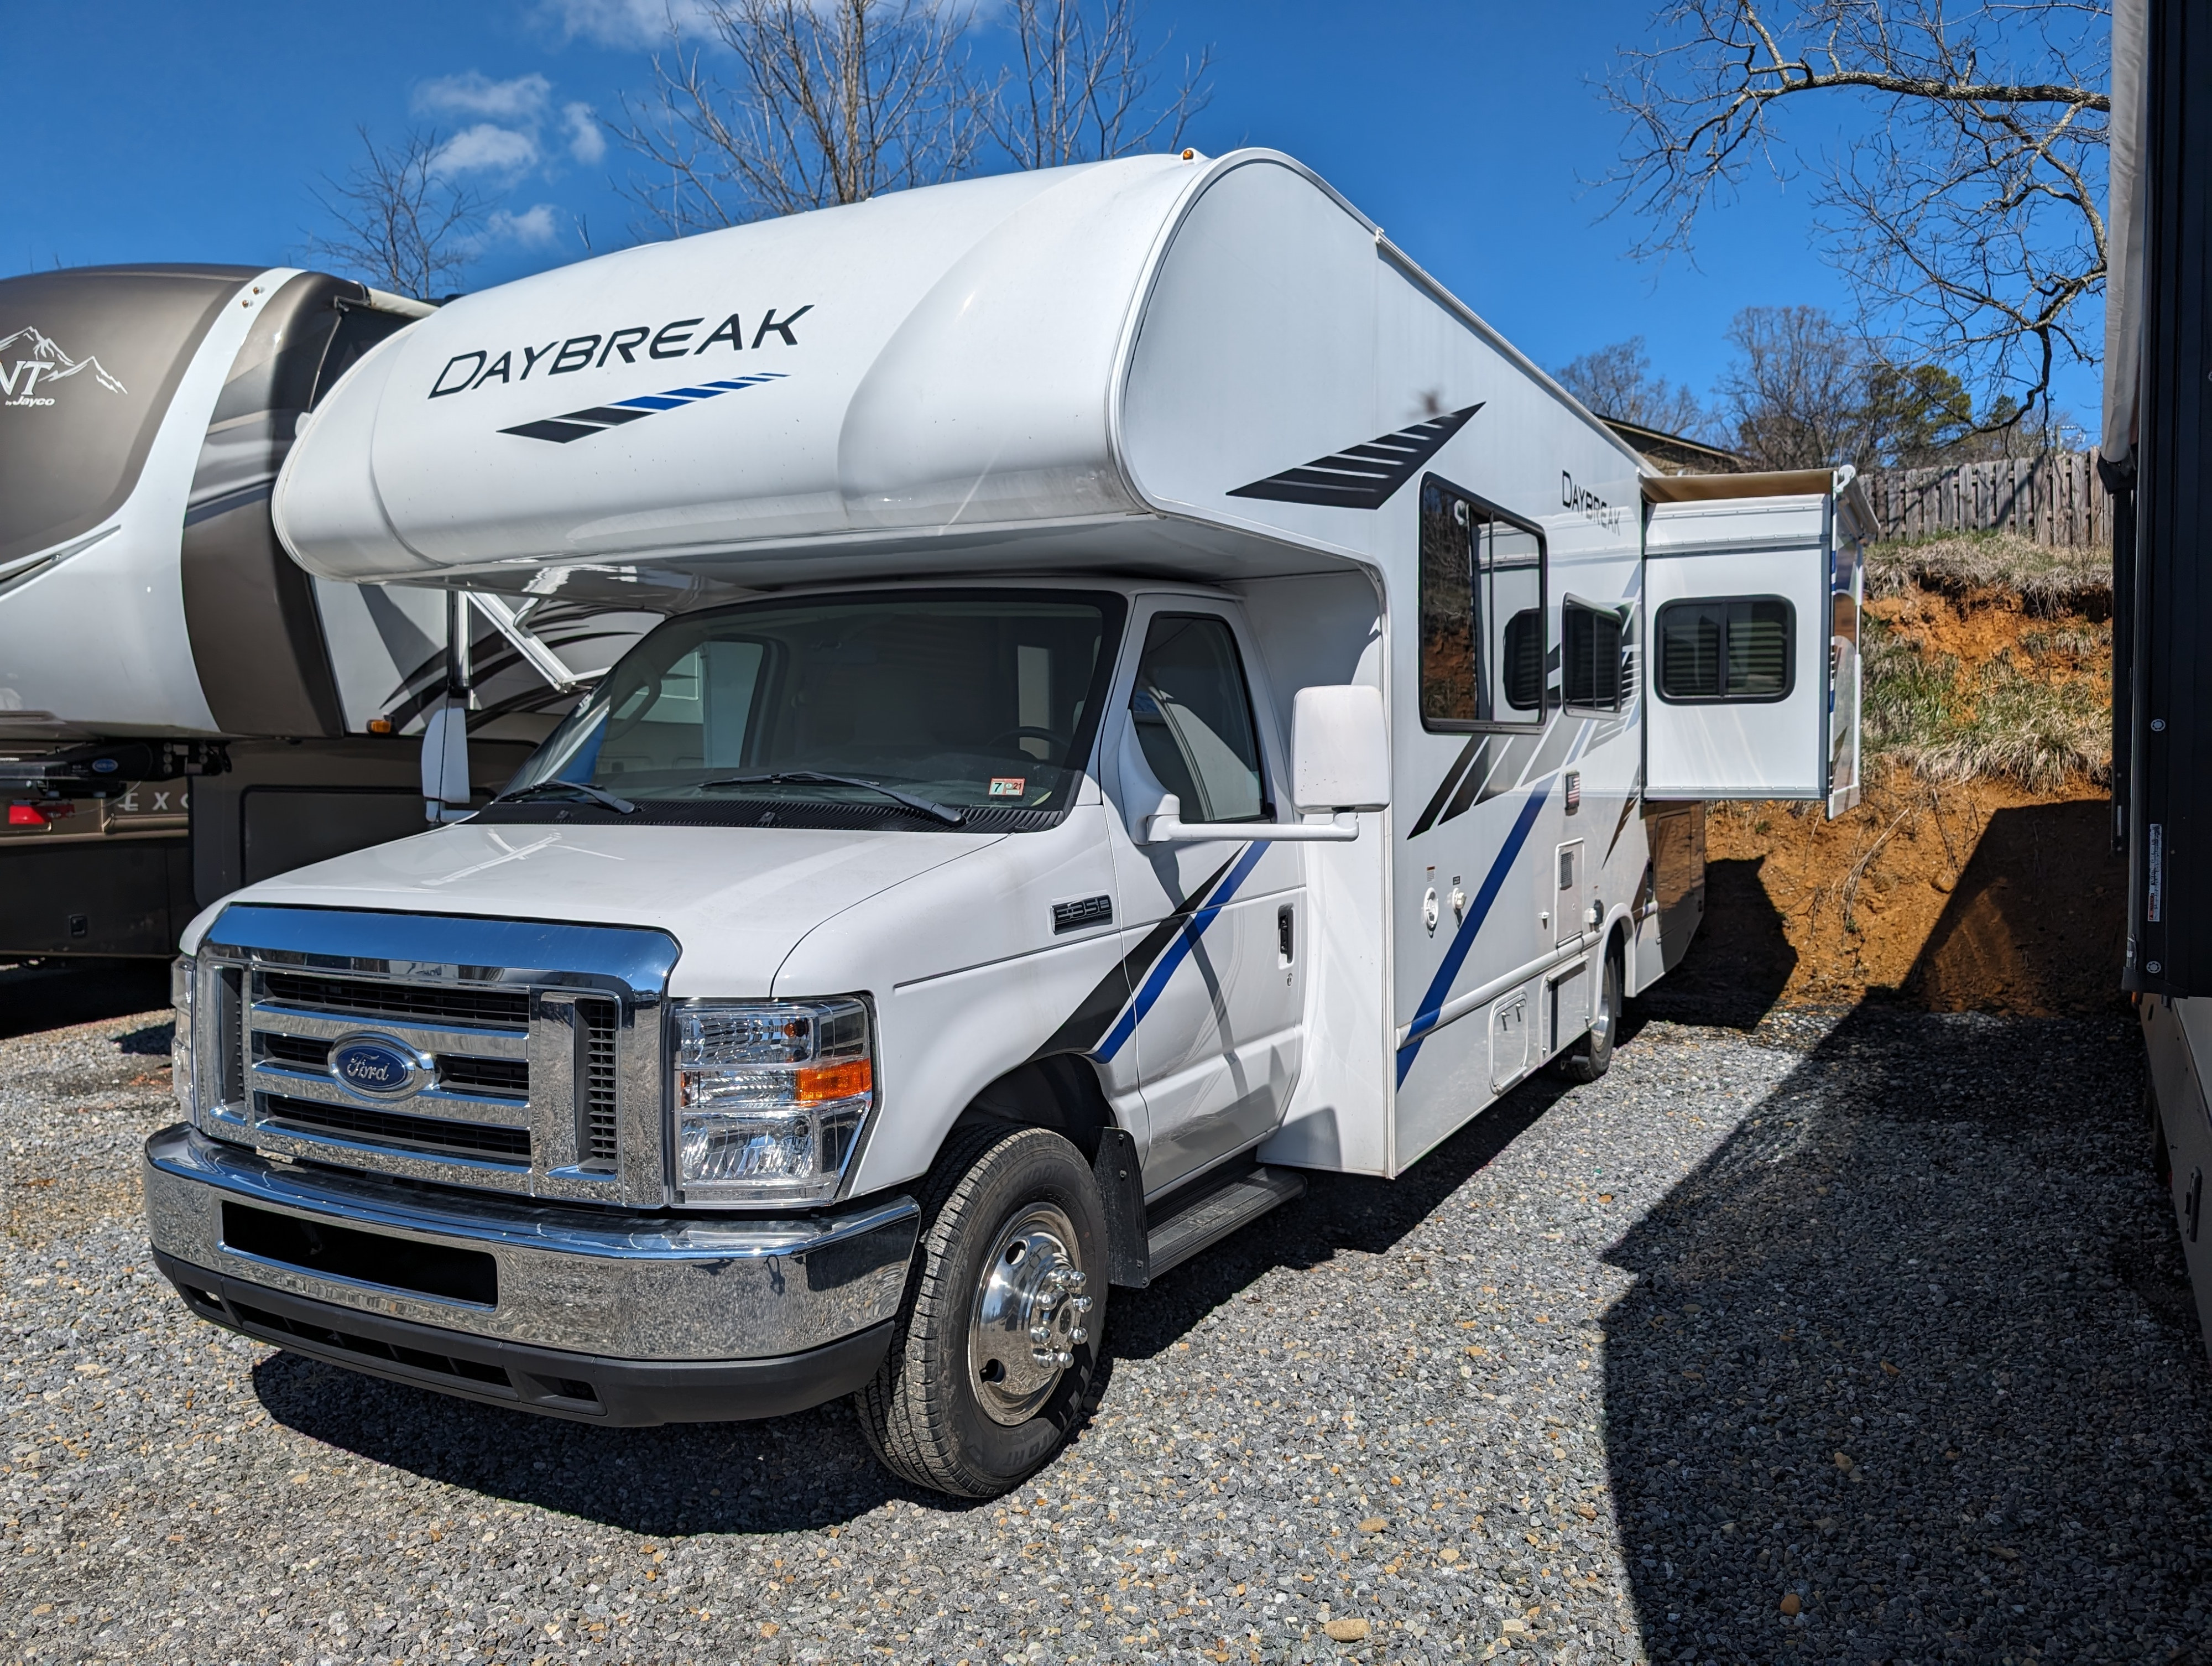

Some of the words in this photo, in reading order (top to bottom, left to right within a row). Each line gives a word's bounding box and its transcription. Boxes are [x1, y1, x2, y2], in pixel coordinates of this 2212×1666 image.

[427, 304, 815, 399] DAYBREAK
[13, 395, 55, 408] Jayco
[1562, 469, 1621, 537] DAYBREAK
[994, 782, 1003, 793] 7
[347, 1051, 390, 1081] Ford
